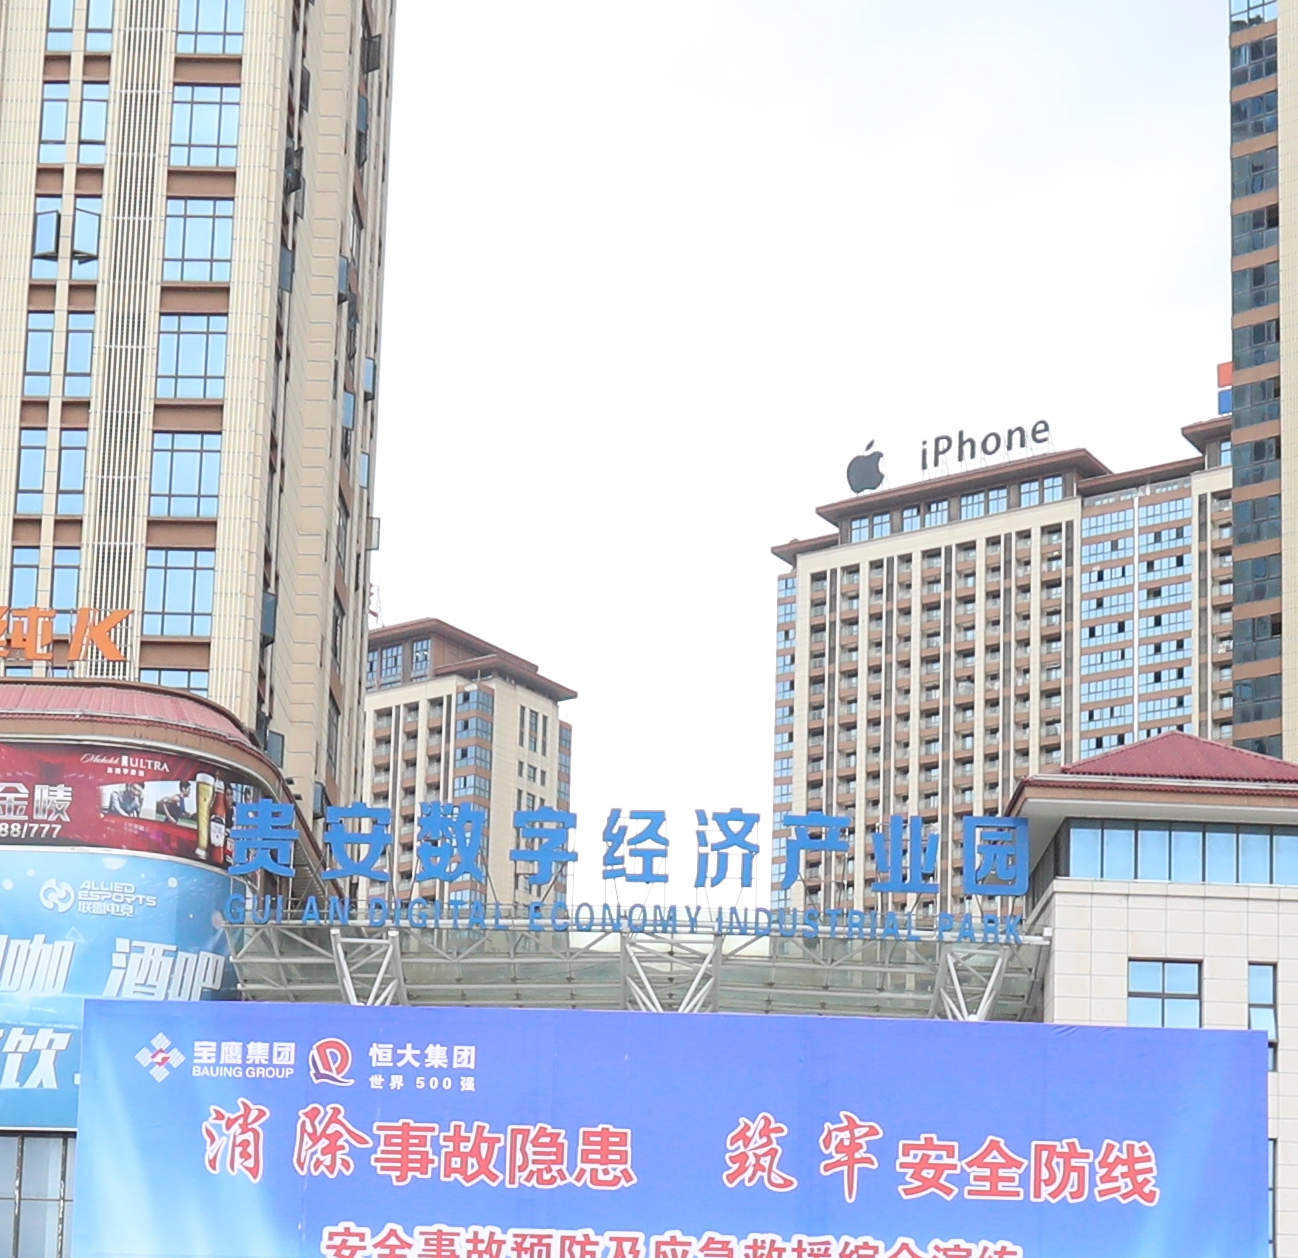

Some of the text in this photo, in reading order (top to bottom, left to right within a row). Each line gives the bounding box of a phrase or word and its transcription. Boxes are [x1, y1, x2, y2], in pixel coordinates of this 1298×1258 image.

[921, 420, 1050, 470] iPhone
[129, 757, 170, 773] ULTRA
[228, 798, 1030, 896] 贵安数字经济产业园
[78, 880, 136, 893] ALLIED
[78, 892, 158, 908] ESPORTS
[224, 893, 1023, 945] GUI AN DIGITAL ECONOMY INDUSTRIAL PARK
[101, 936, 226, 1001] 酒吧
[193, 1040, 297, 1066] 宝鹰集团
[369, 1043, 477, 1071] 恒大集团
[192, 1065, 295, 1080] BAUING GROUP
[368, 1074, 477, 1092] 世界 500 强
[202, 1098, 639, 1190] 消除事故隐患
[723, 1111, 1161, 1205] 筑牢安全防线
